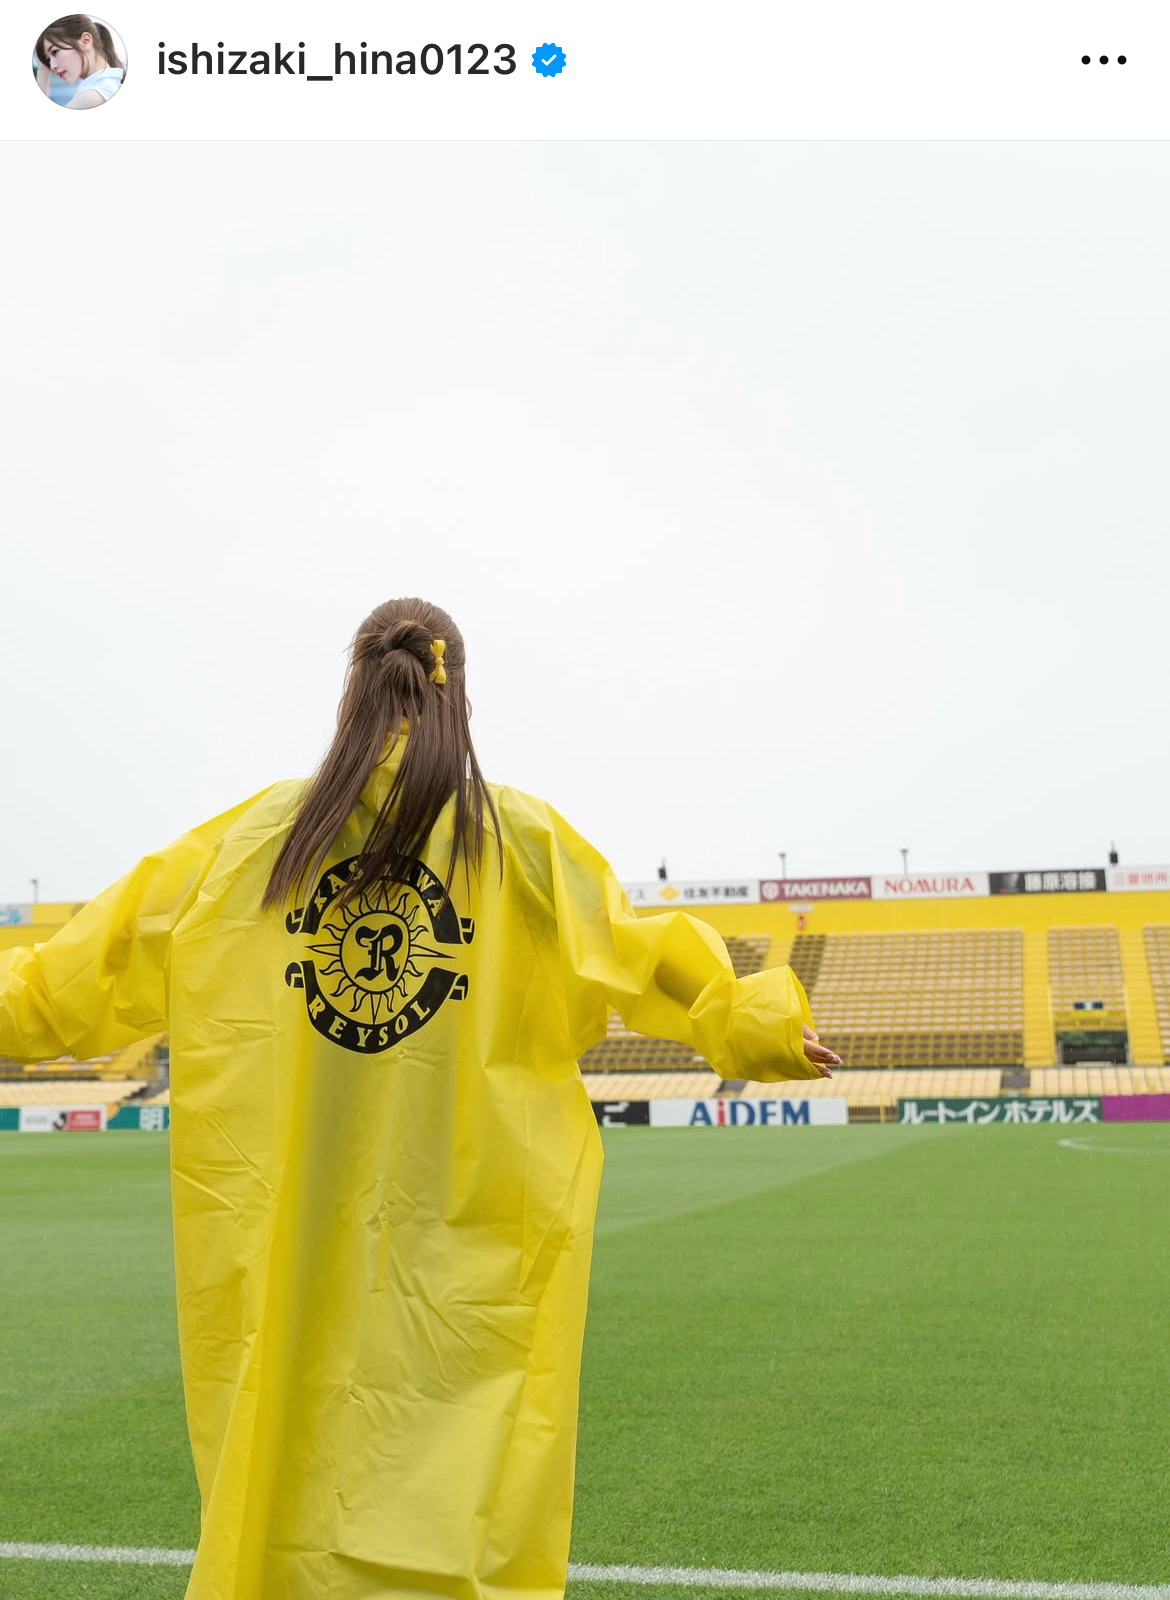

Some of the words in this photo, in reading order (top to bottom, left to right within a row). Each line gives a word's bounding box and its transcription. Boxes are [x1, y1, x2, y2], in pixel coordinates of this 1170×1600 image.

[313, 860, 444, 917] KASWA
[782, 880, 869, 897] TAKENAKA
[884, 877, 974, 893] NOMURA
[355, 924, 403, 981] R
[309, 995, 430, 1047] REYSOL
